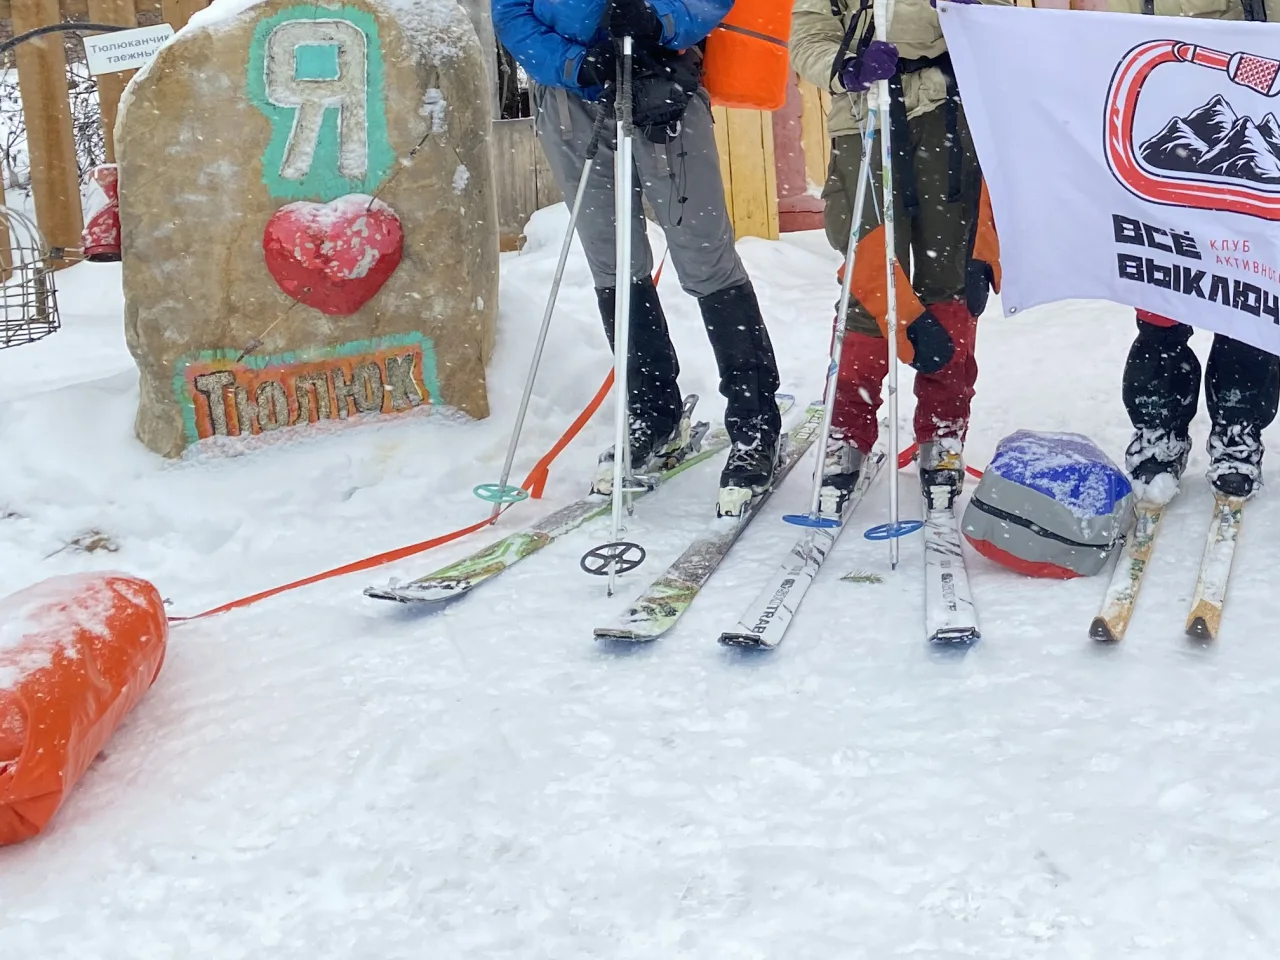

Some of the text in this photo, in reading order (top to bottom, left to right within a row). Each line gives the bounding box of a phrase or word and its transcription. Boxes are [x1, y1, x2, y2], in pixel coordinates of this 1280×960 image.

[107, 46, 160, 63] таежны
[264, 18, 368, 180] Я
[1111, 213, 1203, 261] ВСЁ
[1209, 239, 1251, 253] КЛУБ
